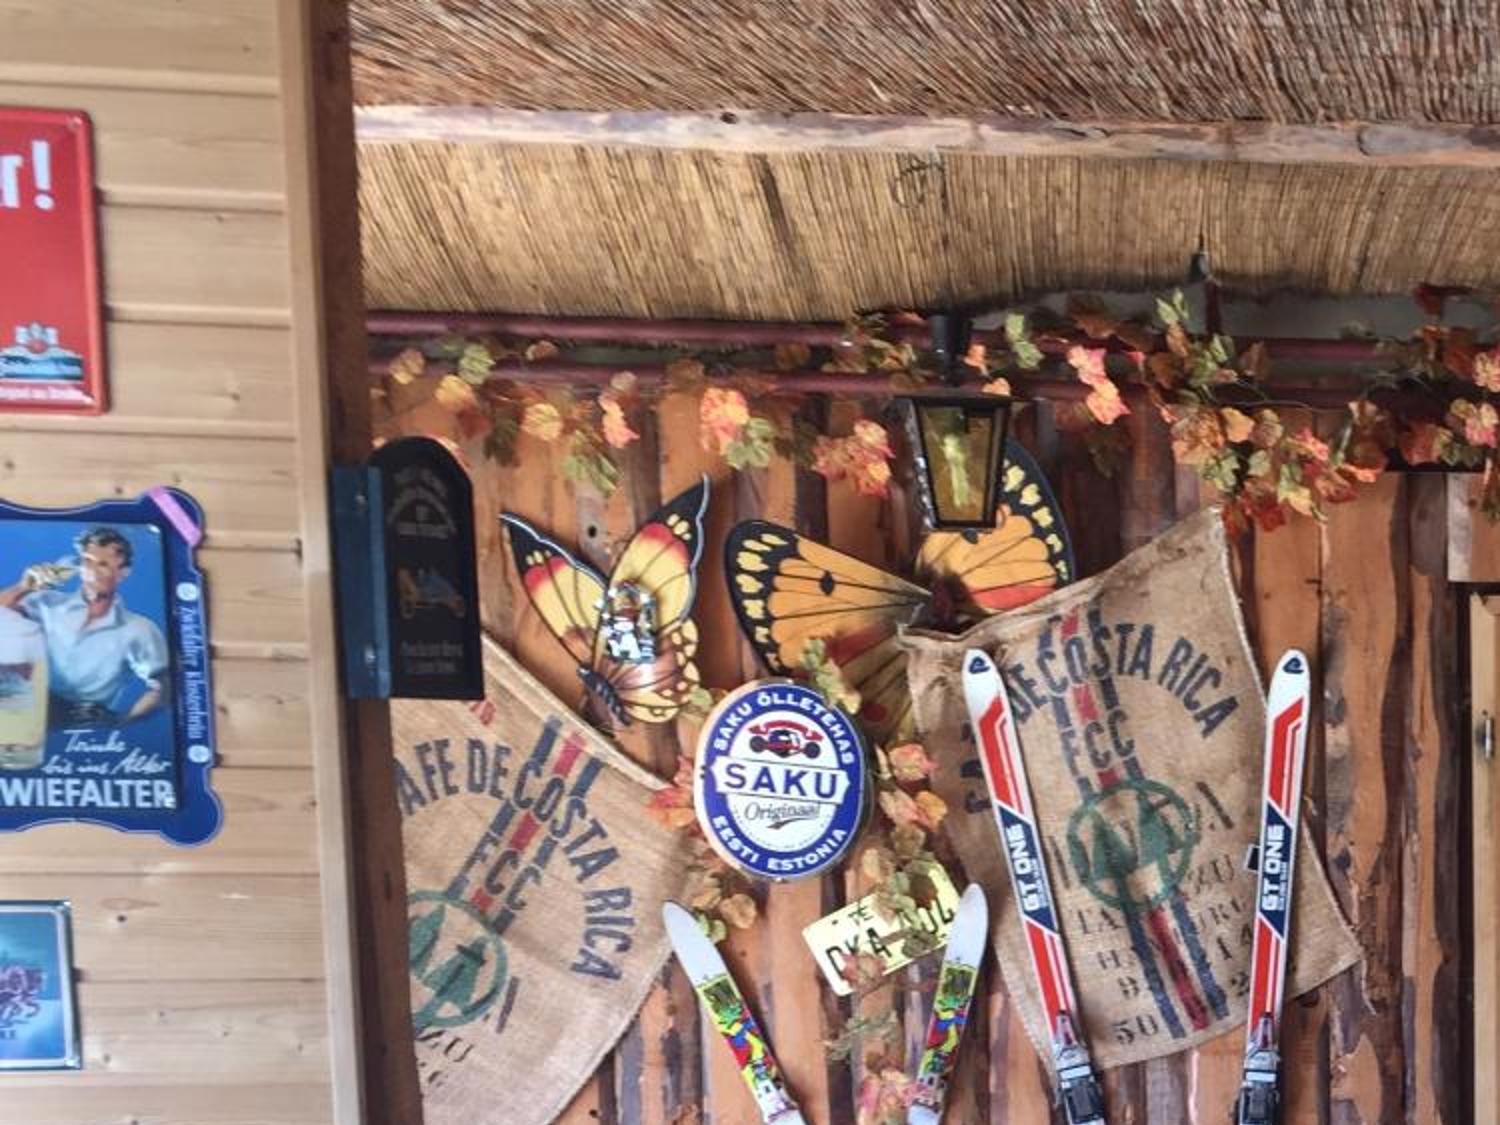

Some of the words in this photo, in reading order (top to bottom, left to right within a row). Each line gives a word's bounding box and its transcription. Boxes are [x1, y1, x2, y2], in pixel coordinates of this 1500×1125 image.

[1036, 622, 1153, 693] COSTA
[1158, 636, 1240, 738] RICA
[64, 729, 127, 752] Trinke
[714, 702, 753, 752] SAKU
[723, 762, 838, 799] SAKU
[466, 738, 514, 800] DE
[513, 760, 621, 885] COSTA
[569, 887, 634, 981] RICA
[712, 815, 760, 863] EESTI
[767, 829, 848, 871] ESTONIA
[1005, 823, 1035, 876] ONE
[1264, 824, 1286, 875] ONE
